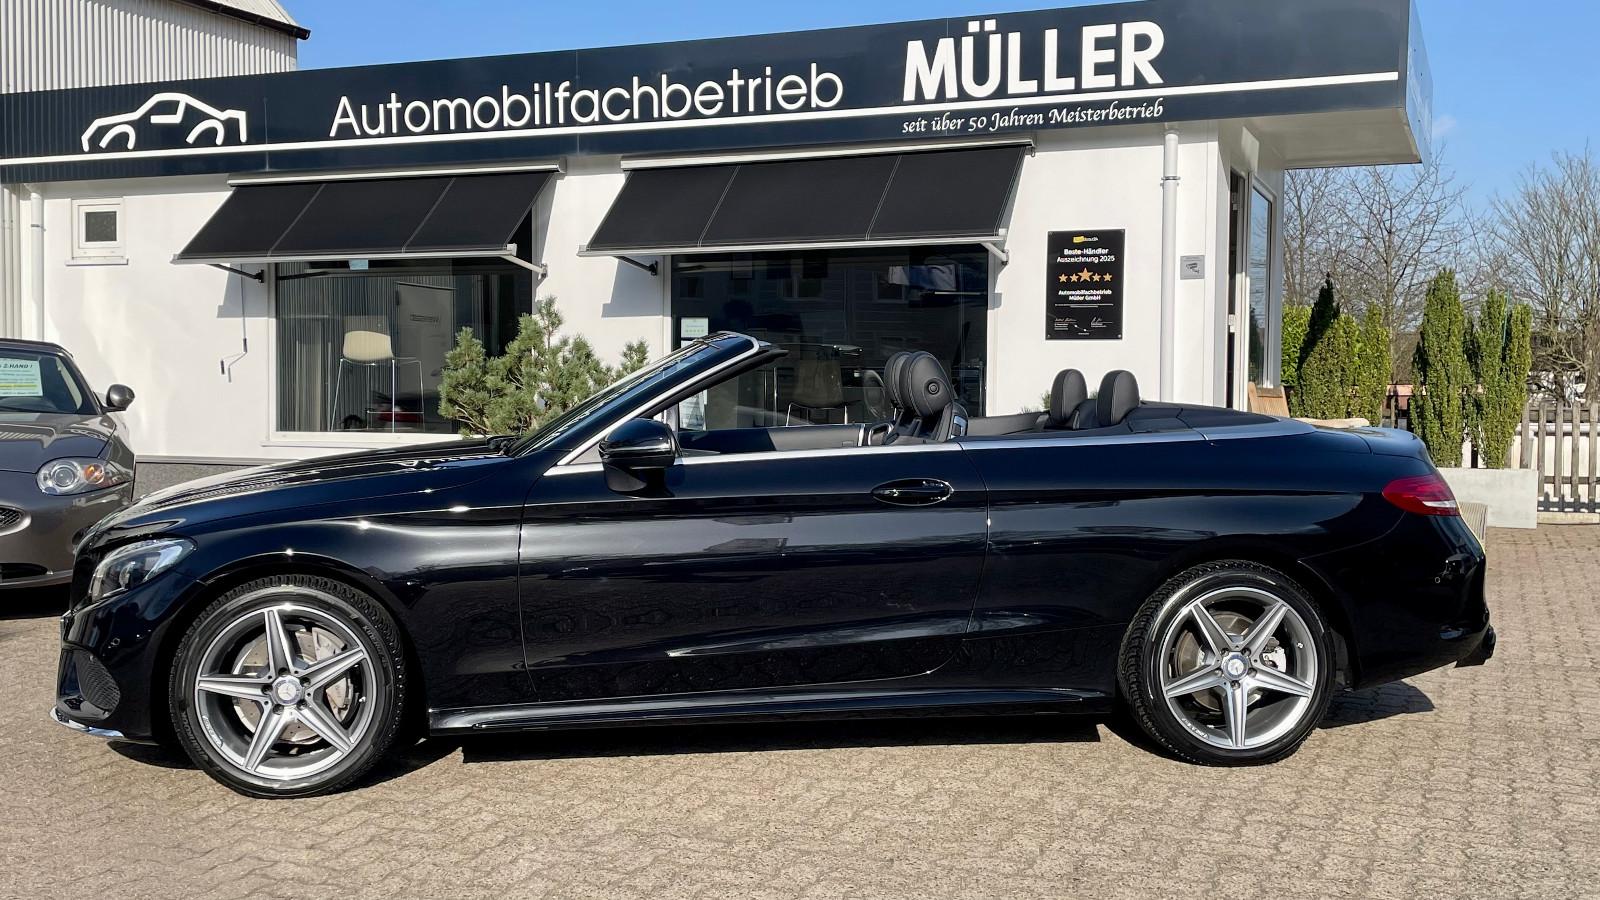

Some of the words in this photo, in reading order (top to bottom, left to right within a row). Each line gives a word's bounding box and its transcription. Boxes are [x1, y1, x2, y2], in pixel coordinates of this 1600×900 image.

[903, 19, 1165, 102] MÜLLER
[329, 62, 844, 137] Automobilfachbetrieb
[902, 119, 928, 133] seit
[930, 111, 965, 131] über
[967, 116, 987, 132] 50
[989, 107, 1045, 132] Jahren
[1048, 97, 1164, 124] Meisterbetrieb
